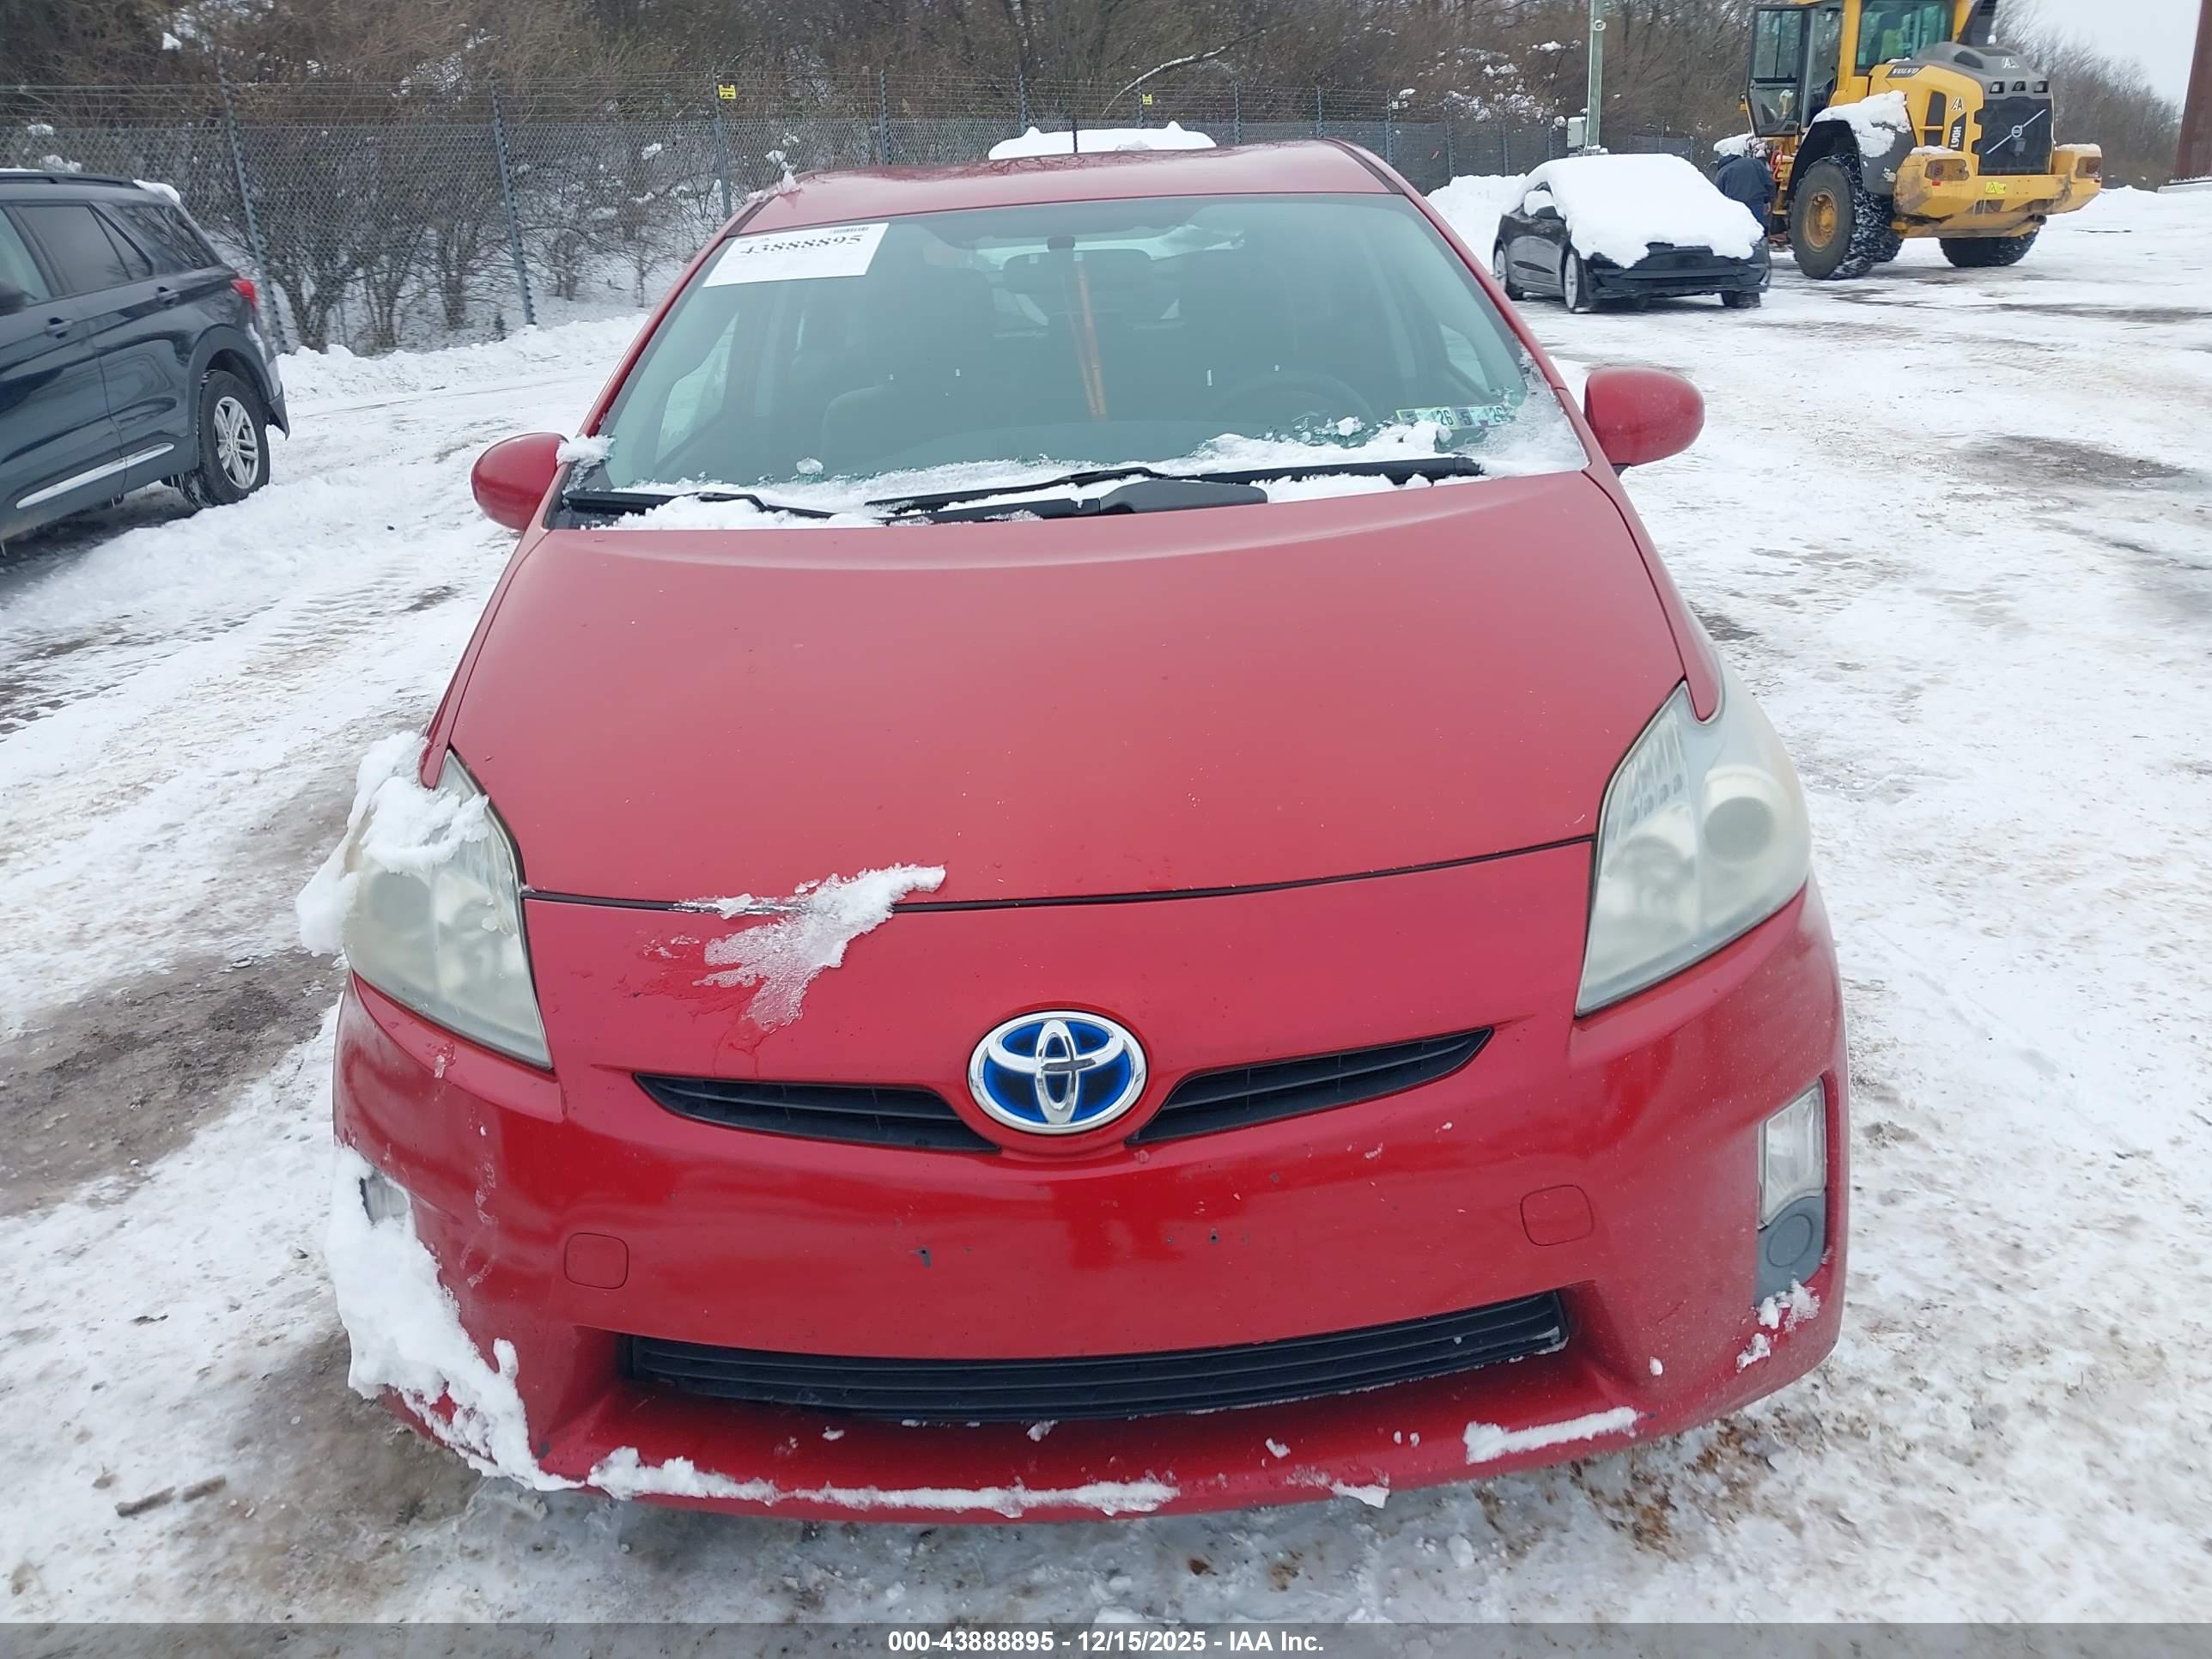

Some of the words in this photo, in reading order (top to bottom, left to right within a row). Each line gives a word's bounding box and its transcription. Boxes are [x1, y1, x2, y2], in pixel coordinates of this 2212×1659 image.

[1892, 67, 1918, 76] VOLVO
[1950, 126, 1962, 149] L90H
[1437, 410, 1454, 426] 26
